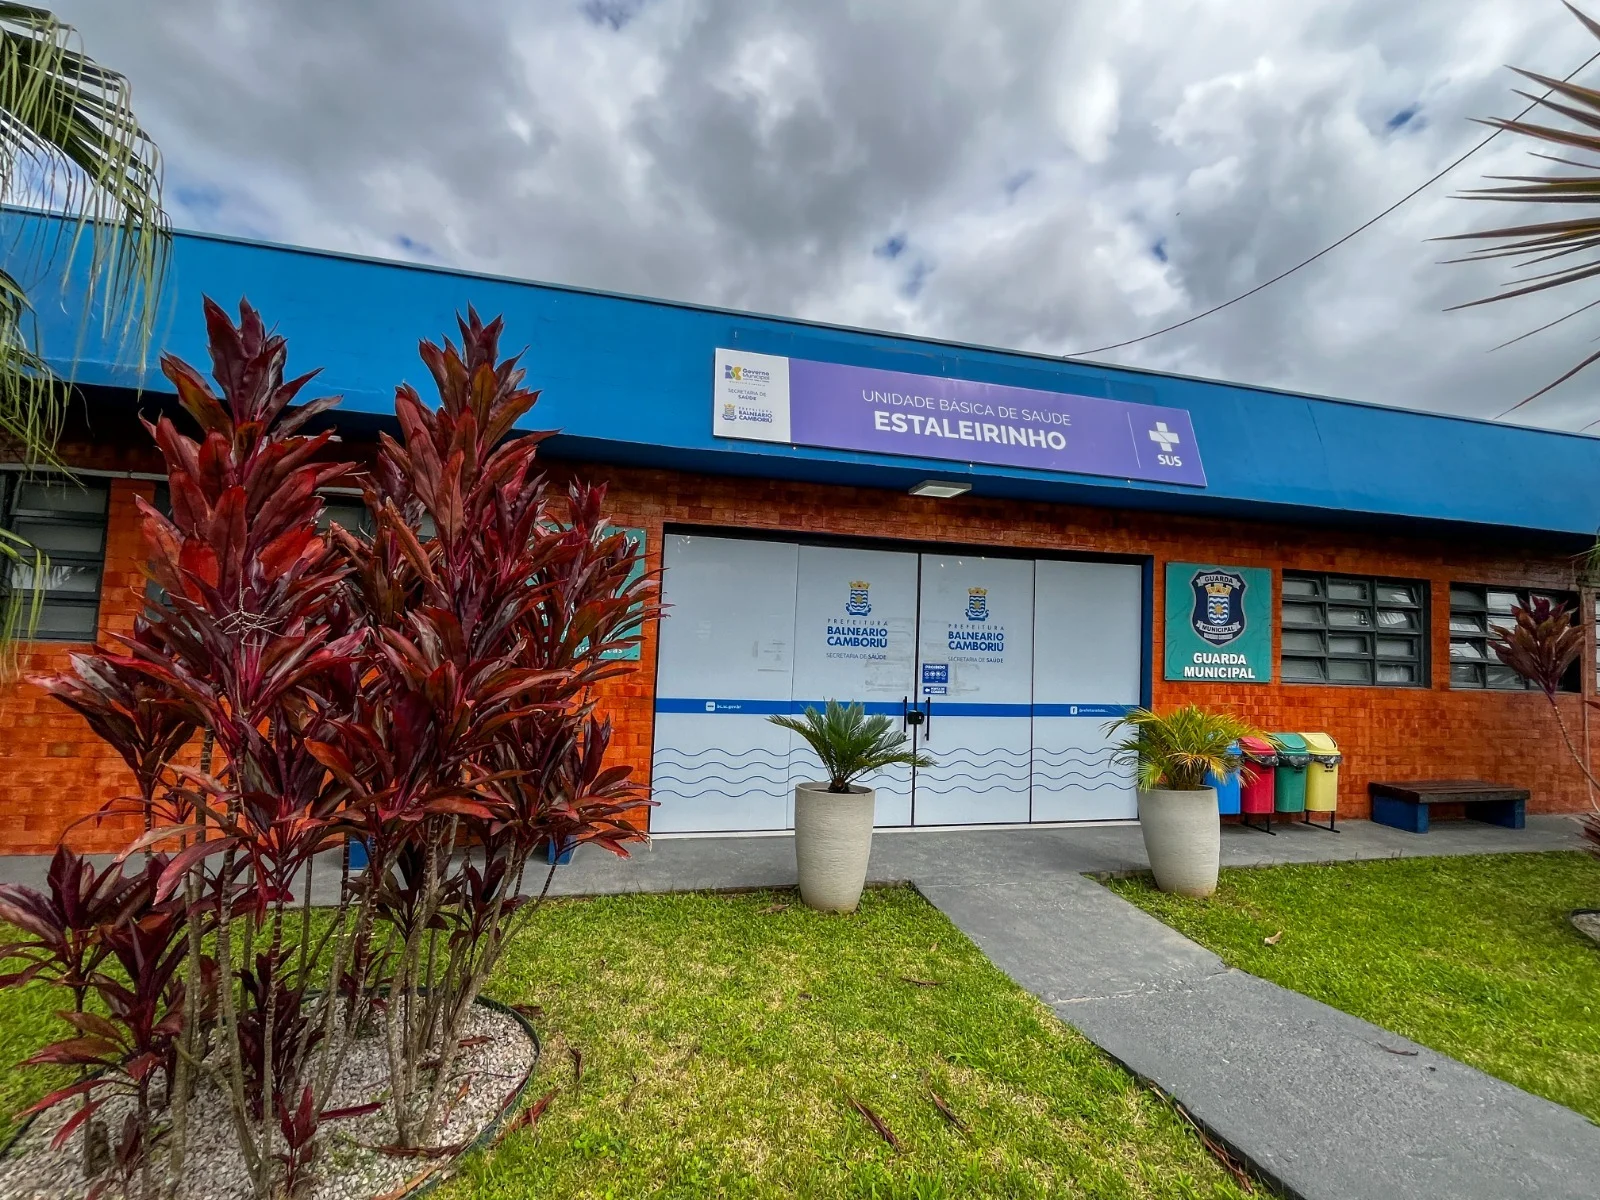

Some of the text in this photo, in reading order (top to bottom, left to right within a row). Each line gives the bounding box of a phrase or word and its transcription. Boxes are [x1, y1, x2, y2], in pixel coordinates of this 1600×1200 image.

[862, 389, 1072, 426] UNIDADE BÁSICA DE SAÚDE
[874, 410, 1066, 450] ESTALEIRINHO
[1157, 454, 1182, 467] SUS
[1204, 575, 1234, 584] GUARDA
[827, 618, 888, 626] PREFEITURA
[827, 626, 888, 637] BALNEÁRIO
[1201, 624, 1235, 633] MUNICIPAL
[827, 636, 888, 648] CAMBORIÚ
[948, 631, 1004, 641] BALNEÁRIO
[948, 640, 1004, 652] CAMBORIÚ
[1193, 652, 1247, 665] GUARDA
[1184, 666, 1255, 679] MUNICIPAL
